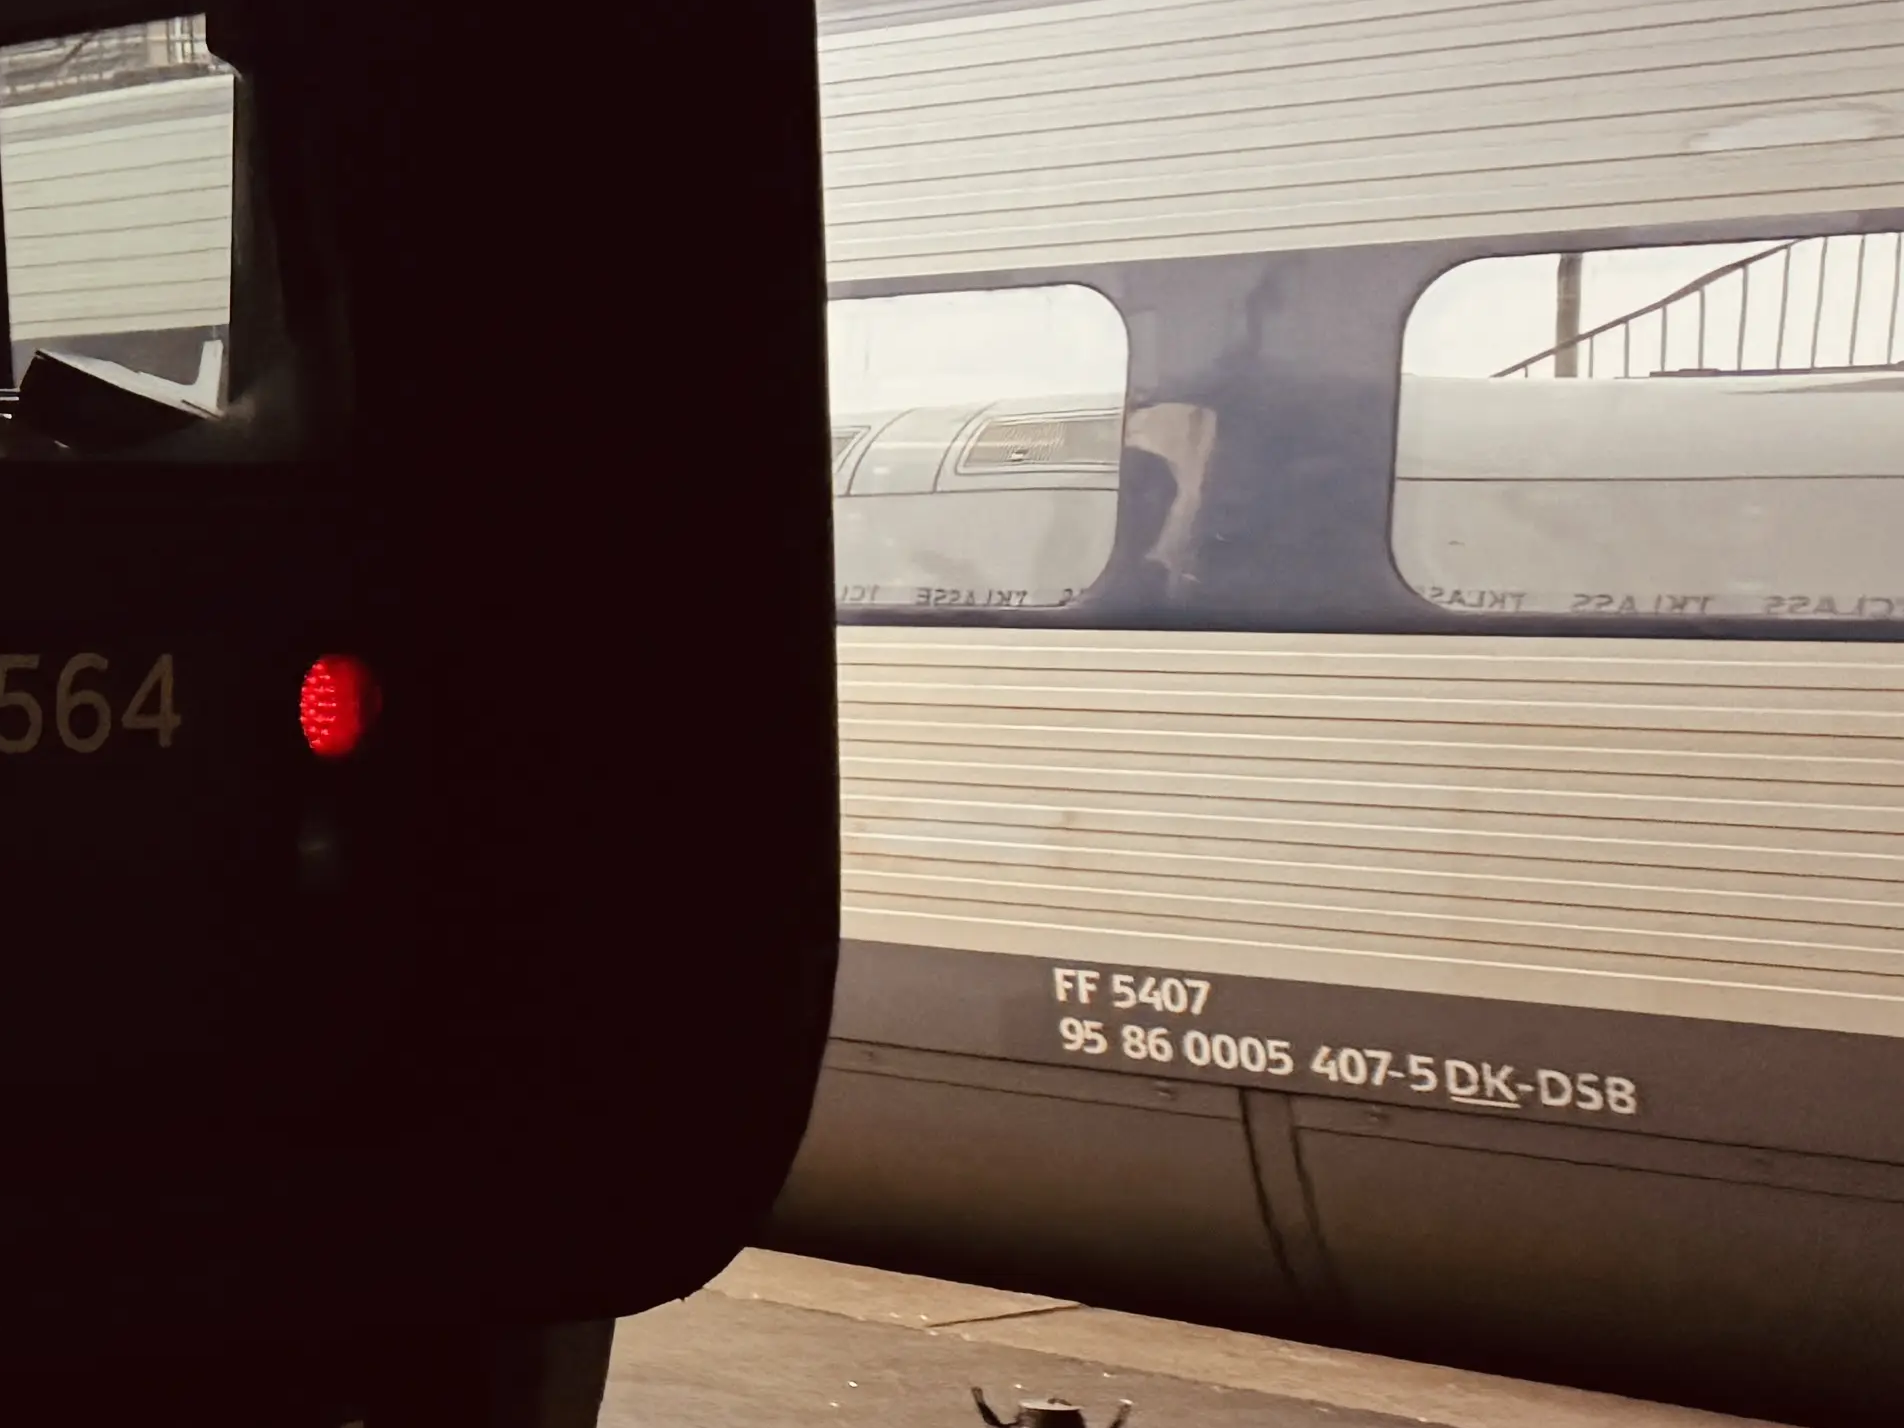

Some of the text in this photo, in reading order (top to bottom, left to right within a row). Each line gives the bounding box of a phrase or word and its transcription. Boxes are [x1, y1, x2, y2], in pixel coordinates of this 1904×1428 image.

[1053, 967, 1211, 1015] FF 5407
[1059, 1016, 1108, 1055] 95
[1120, 1023, 1174, 1063] 86
[1182, 1029, 1294, 1076] 0005
